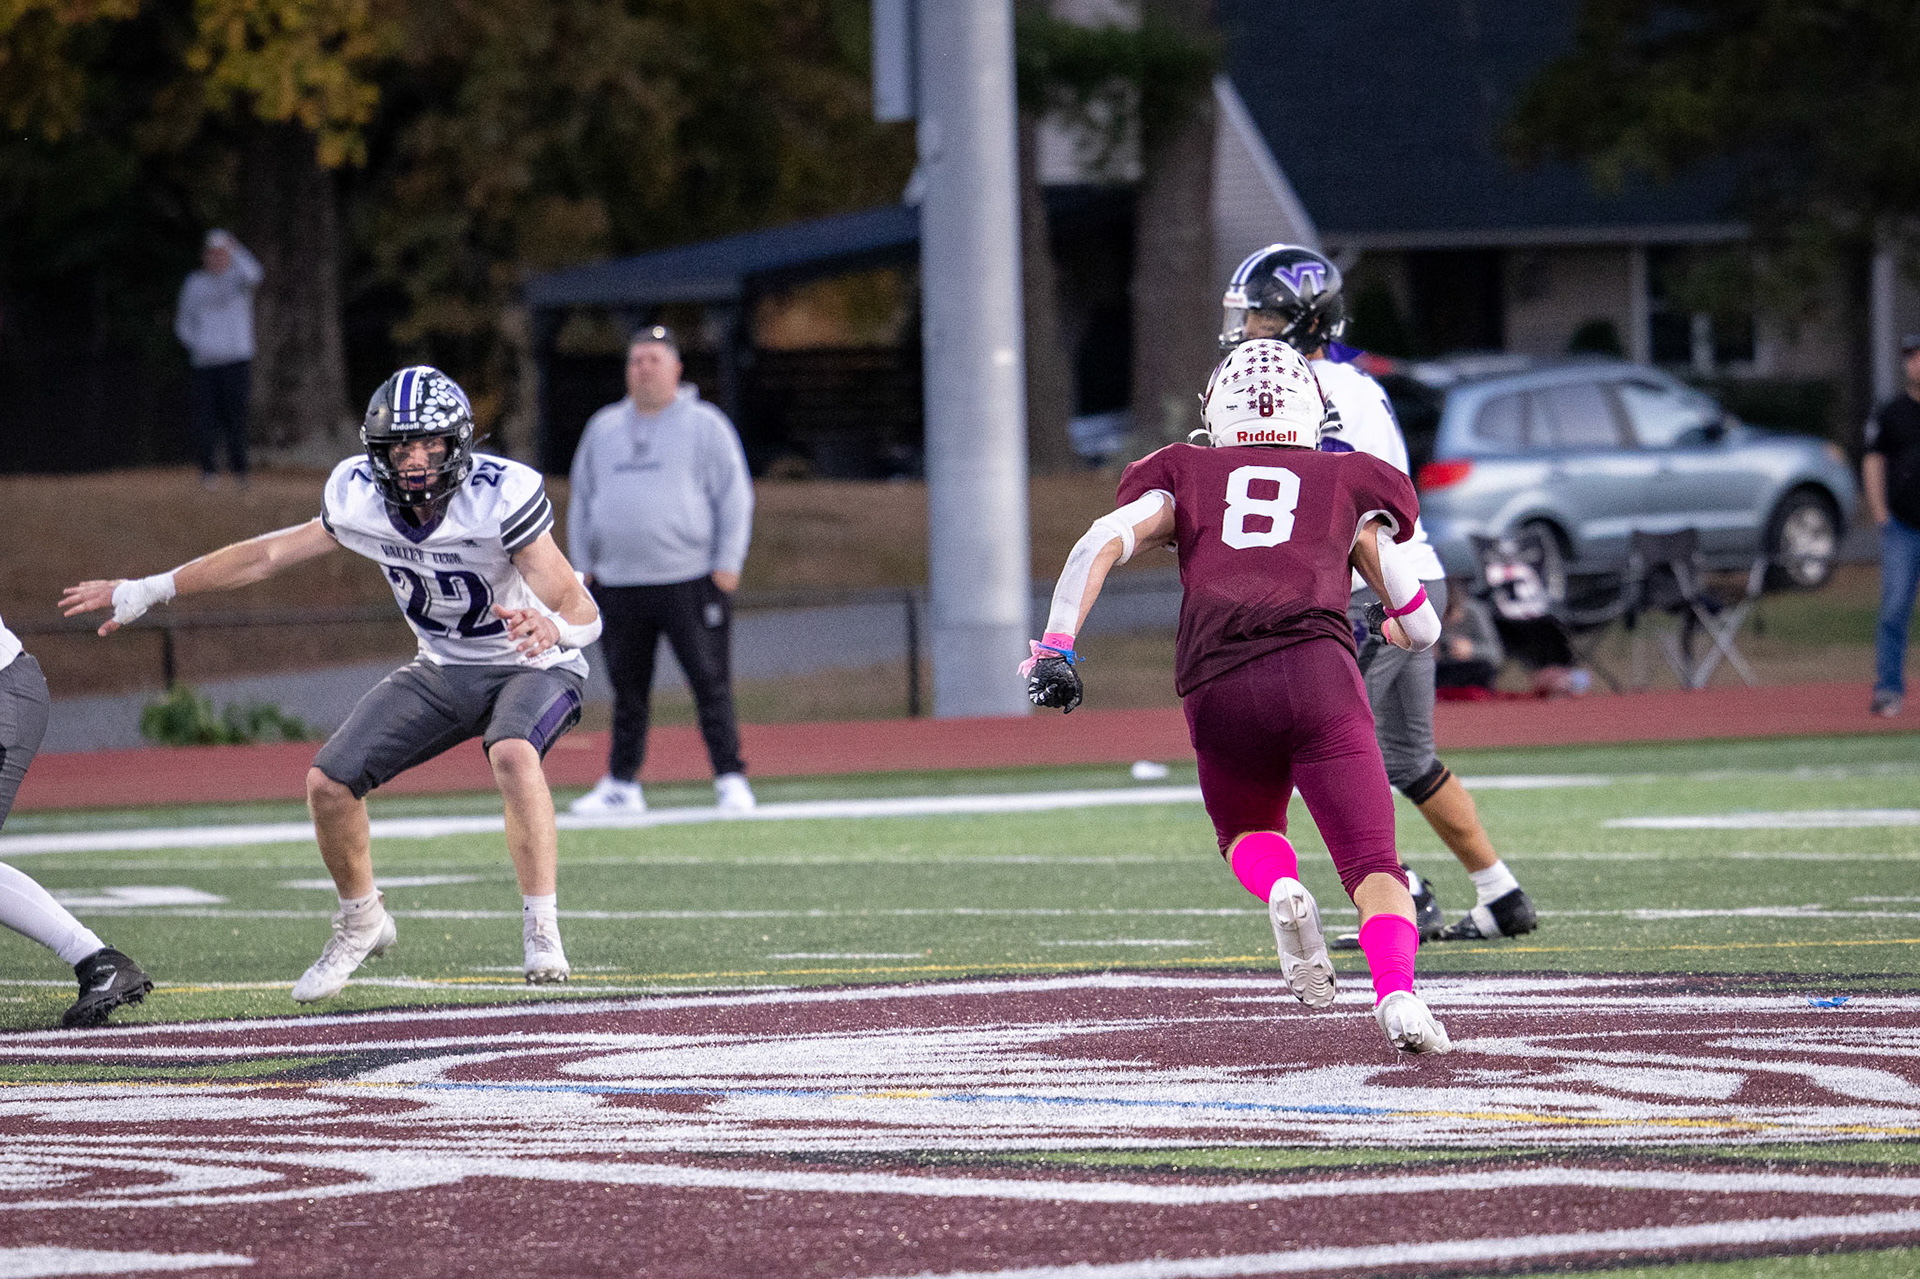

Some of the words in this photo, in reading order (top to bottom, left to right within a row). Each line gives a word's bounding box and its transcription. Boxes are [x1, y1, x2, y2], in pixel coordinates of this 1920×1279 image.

[1272, 261, 1326, 297] VT
[1259, 392, 1274, 417] 8
[391, 422, 420, 431] Riddell
[1237, 430, 1298, 443] Riddell
[1221, 465, 1301, 550] 8
[381, 544, 425, 563] VALLEY
[432, 552, 464, 565] TECH
[388, 566, 509, 639] 22
